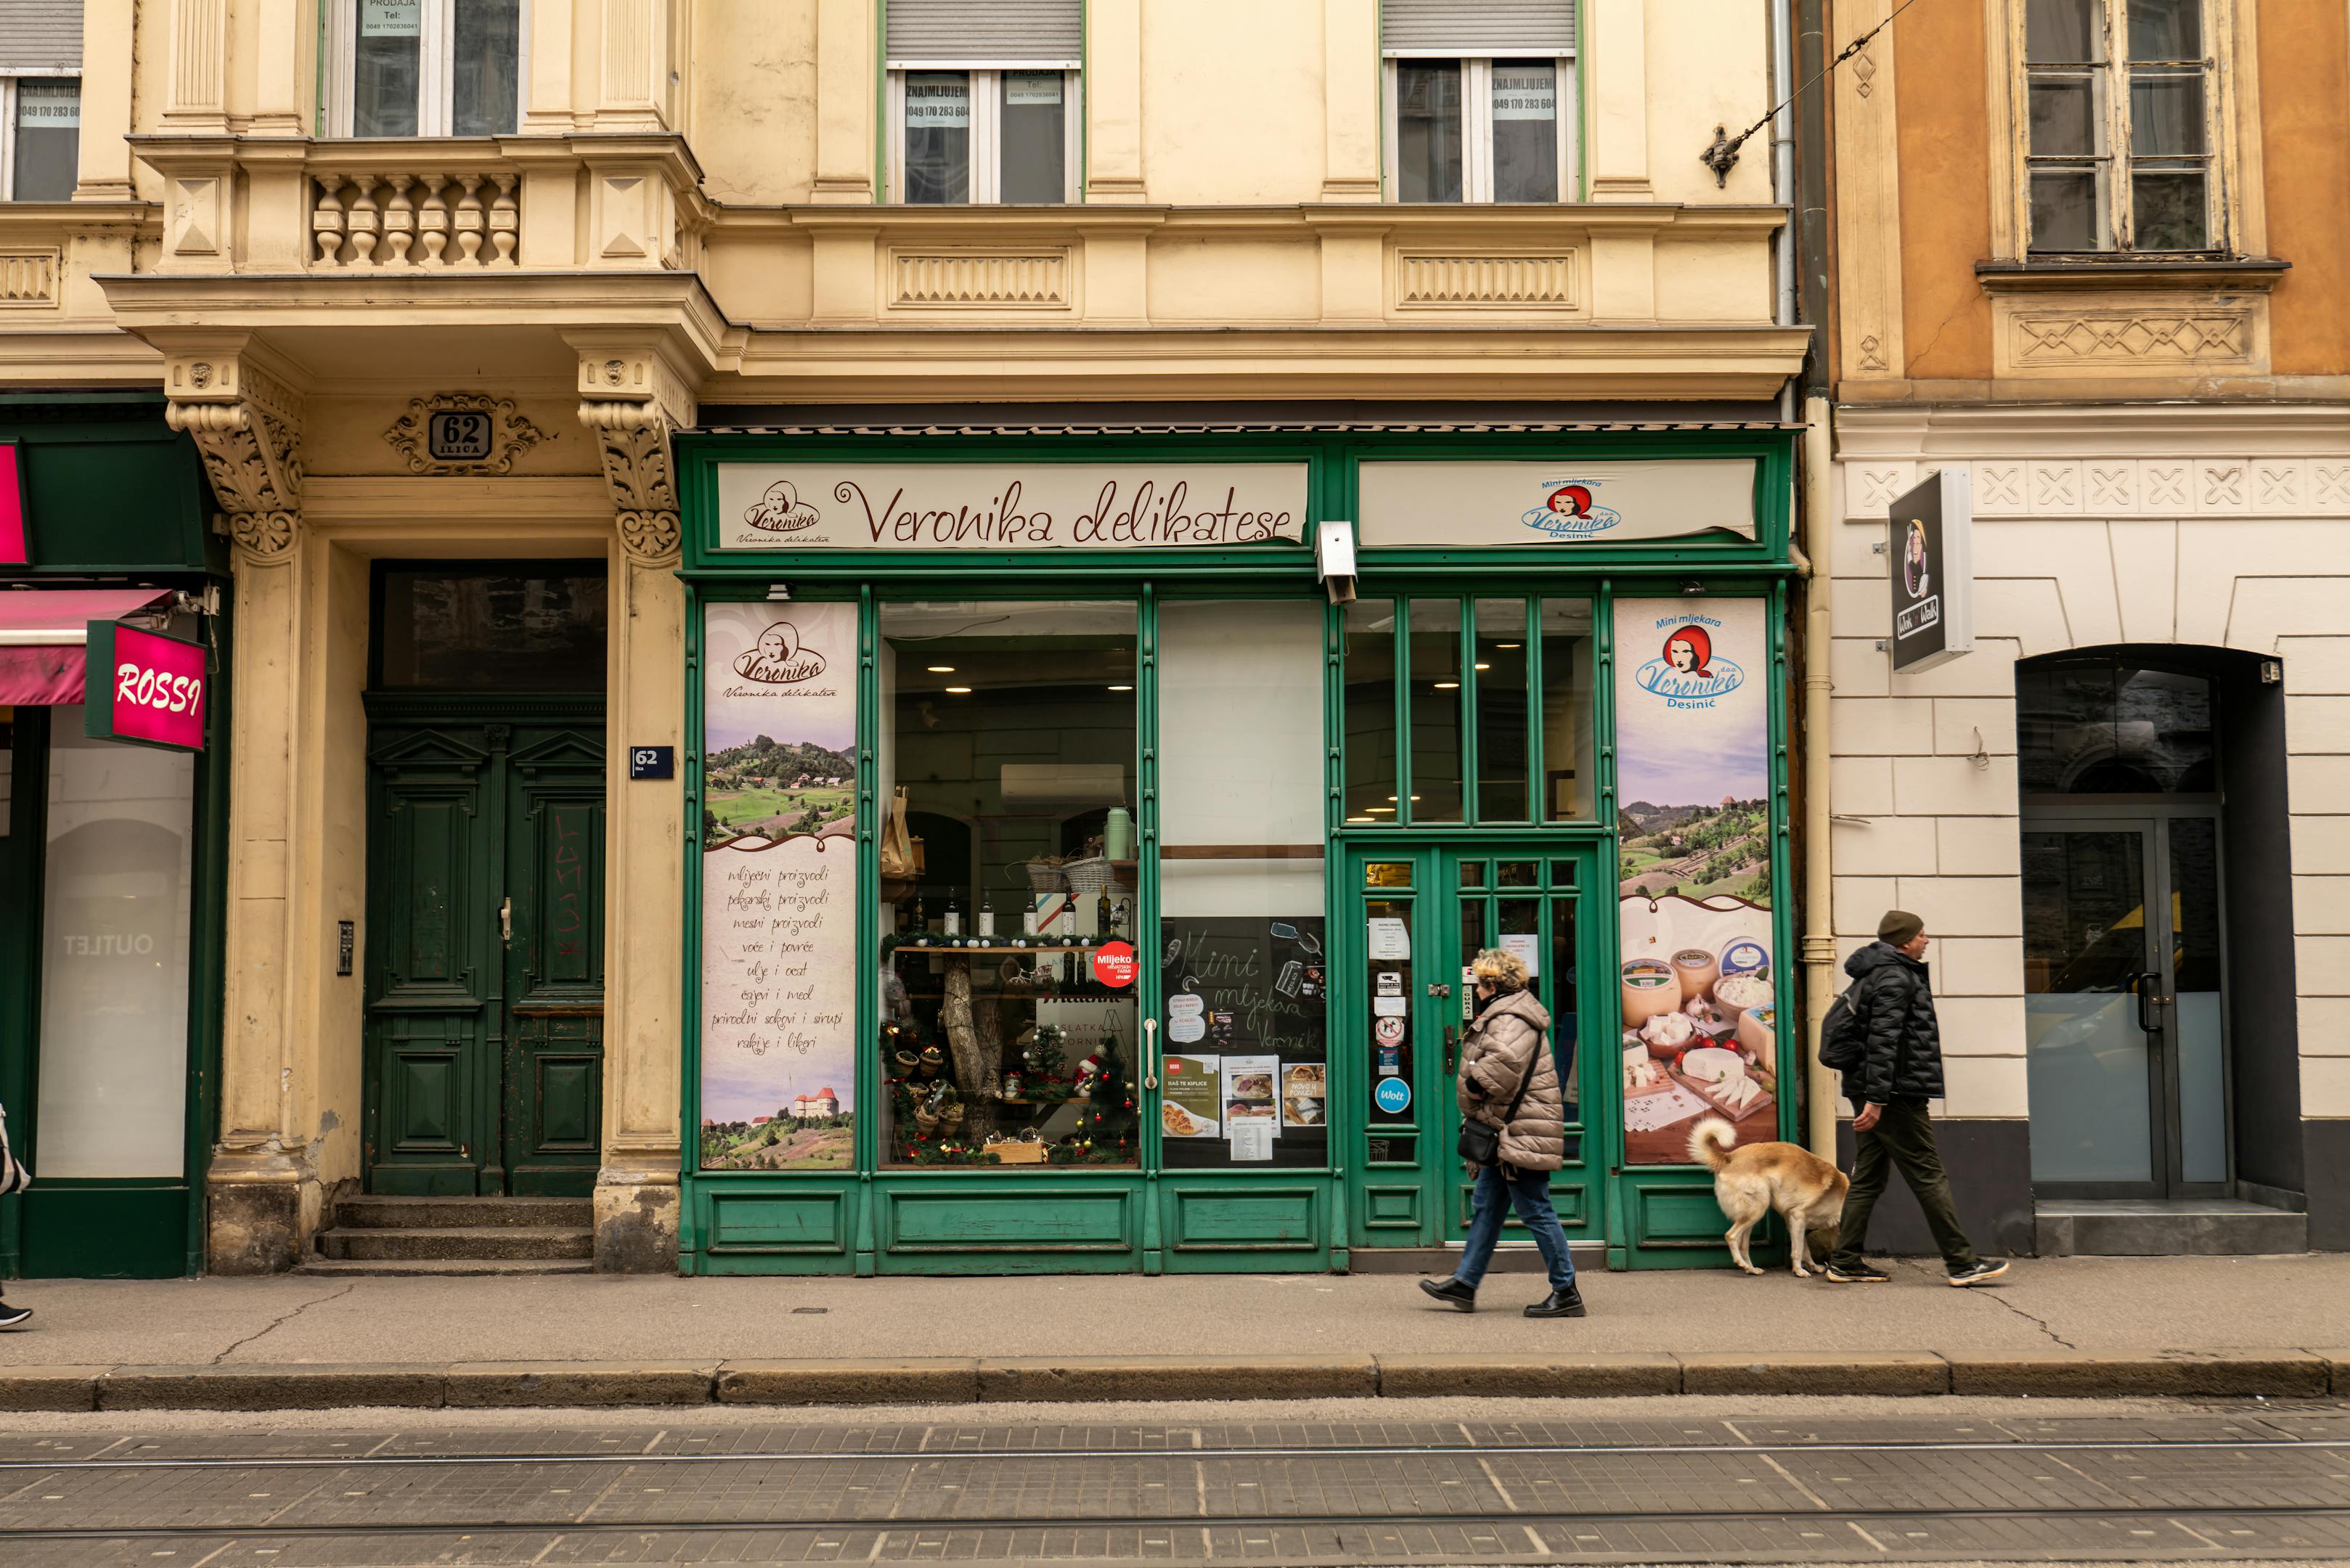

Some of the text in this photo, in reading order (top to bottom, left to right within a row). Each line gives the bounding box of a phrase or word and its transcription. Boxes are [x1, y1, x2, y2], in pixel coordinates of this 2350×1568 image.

[39, 107, 52, 116] 170
[53, 107, 68, 117] 283
[925, 106, 938, 116] 170
[939, 107, 954, 116] 283
[1511, 99, 1523, 109] 170
[1525, 99, 1539, 109] 283
[444, 416, 480, 444] 62
[1562, 478, 1602, 487] mljekara
[751, 507, 816, 530] Veronika
[833, 481, 1290, 543] Veronika delikatese
[1530, 511, 1615, 531] Veronika
[736, 534, 782, 542] Veronika
[1656, 613, 1721, 629] Mini mljekara
[1899, 613, 1912, 634] Wok
[1920, 600, 1937, 624] Walk
[742, 655, 821, 681] Veronika
[117, 663, 201, 716] ROSSI
[1646, 665, 1739, 695] Veronika
[723, 686, 837, 698] Veronika delikatese
[1667, 698, 1716, 709] Desinić
[635, 750, 658, 765] 62
[728, 865, 829, 888] mliječni proizvodi
[727, 889, 829, 912] pekarski proizvodi
[733, 912, 823, 936] mesni proizvodi
[743, 941, 814, 959] voće i povrće
[1097, 955, 1132, 965] Mlijeko
[1175, 929, 1259, 979] Mini
[747, 961, 807, 984] ulje i ocat
[741, 984, 815, 1008] čajevi i med
[1215, 983, 1305, 1032] mljekara
[711, 1009, 844, 1031] prirodni sokovi i sirupi
[738, 1032, 817, 1055] rakije i likeri
[1381, 1090, 1405, 1101] Wolt
